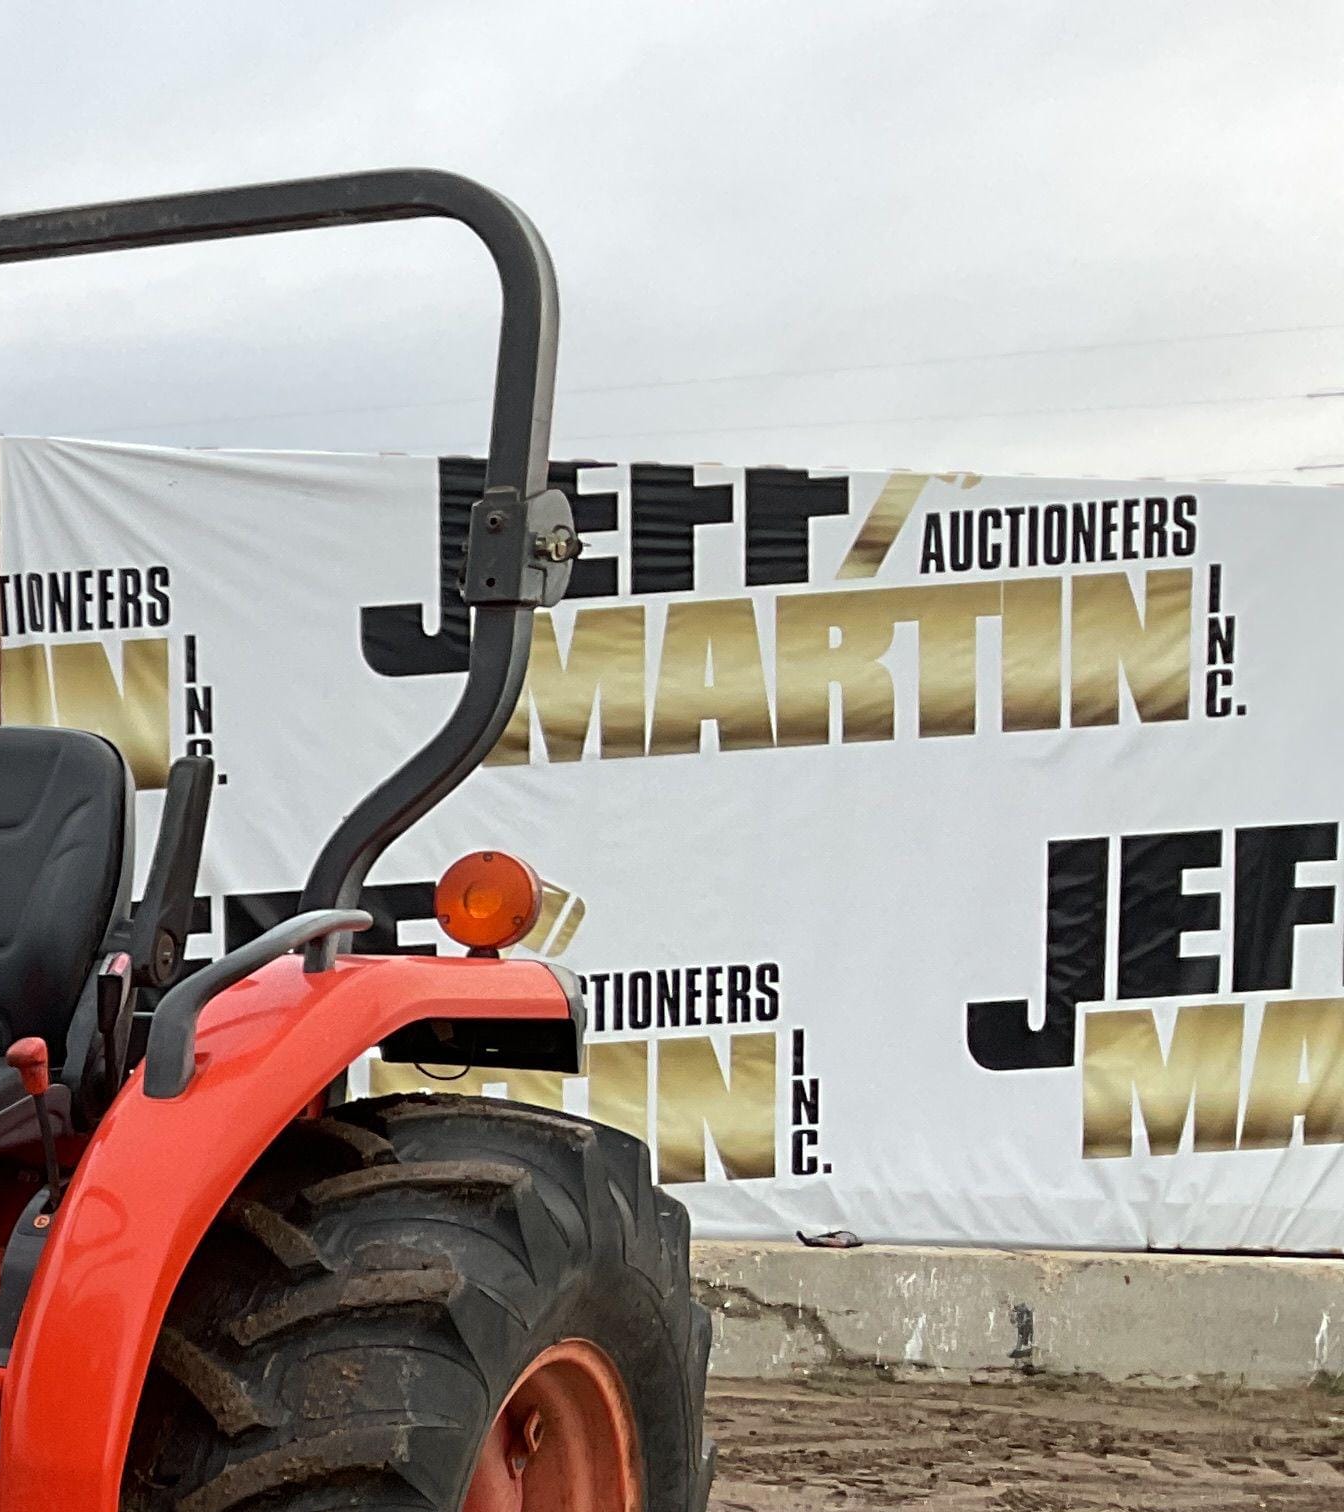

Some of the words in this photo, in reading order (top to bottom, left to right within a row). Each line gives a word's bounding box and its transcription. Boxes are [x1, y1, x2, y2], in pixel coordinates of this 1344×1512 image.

[919, 494, 1198, 575] AUCTIONEERS
[482, 566, 1194, 768] MARTIN
[580, 962, 780, 1031] TIONEERS
[967, 821, 1344, 1071] JEF
